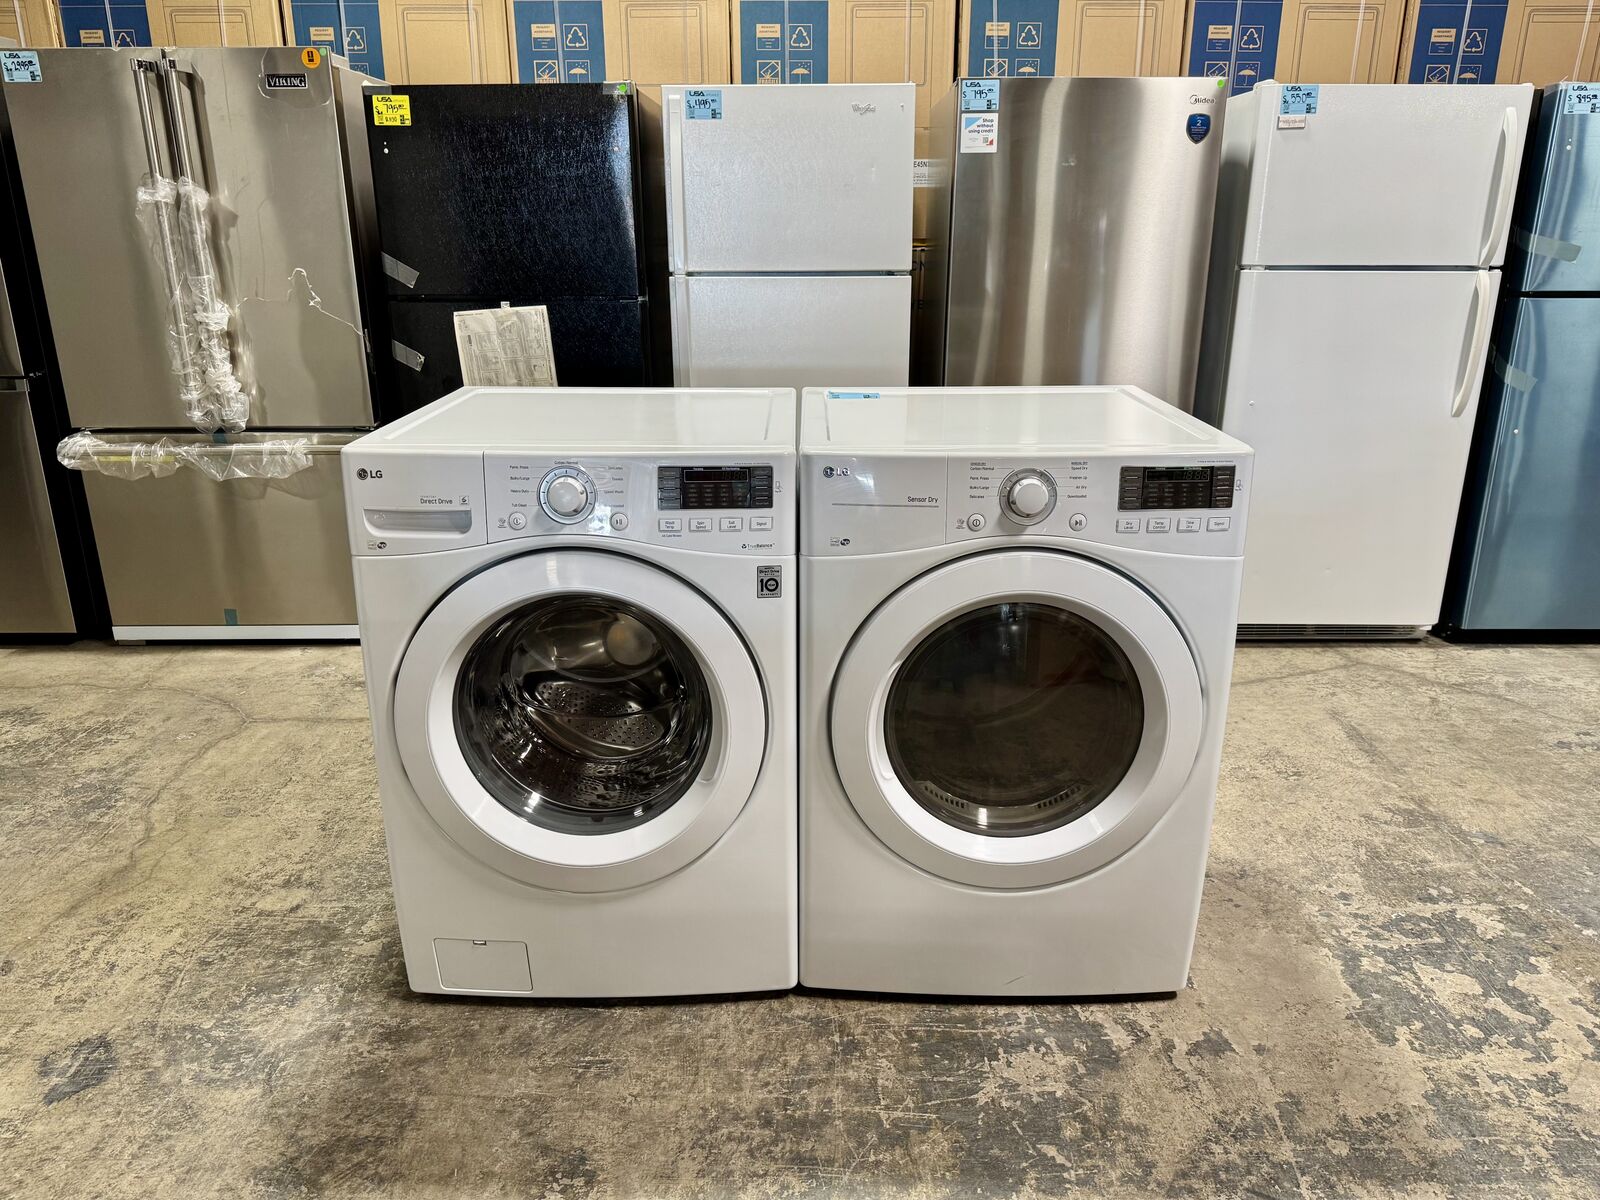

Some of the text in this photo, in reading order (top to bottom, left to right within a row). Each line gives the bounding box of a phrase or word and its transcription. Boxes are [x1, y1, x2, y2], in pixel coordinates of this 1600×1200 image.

[269, 77, 305, 86] VIKING
[1190, 94, 1215, 104] Midea
[370, 470, 383, 478] LG
[836, 467, 850, 476] LG
[760, 578, 779, 592] 10
